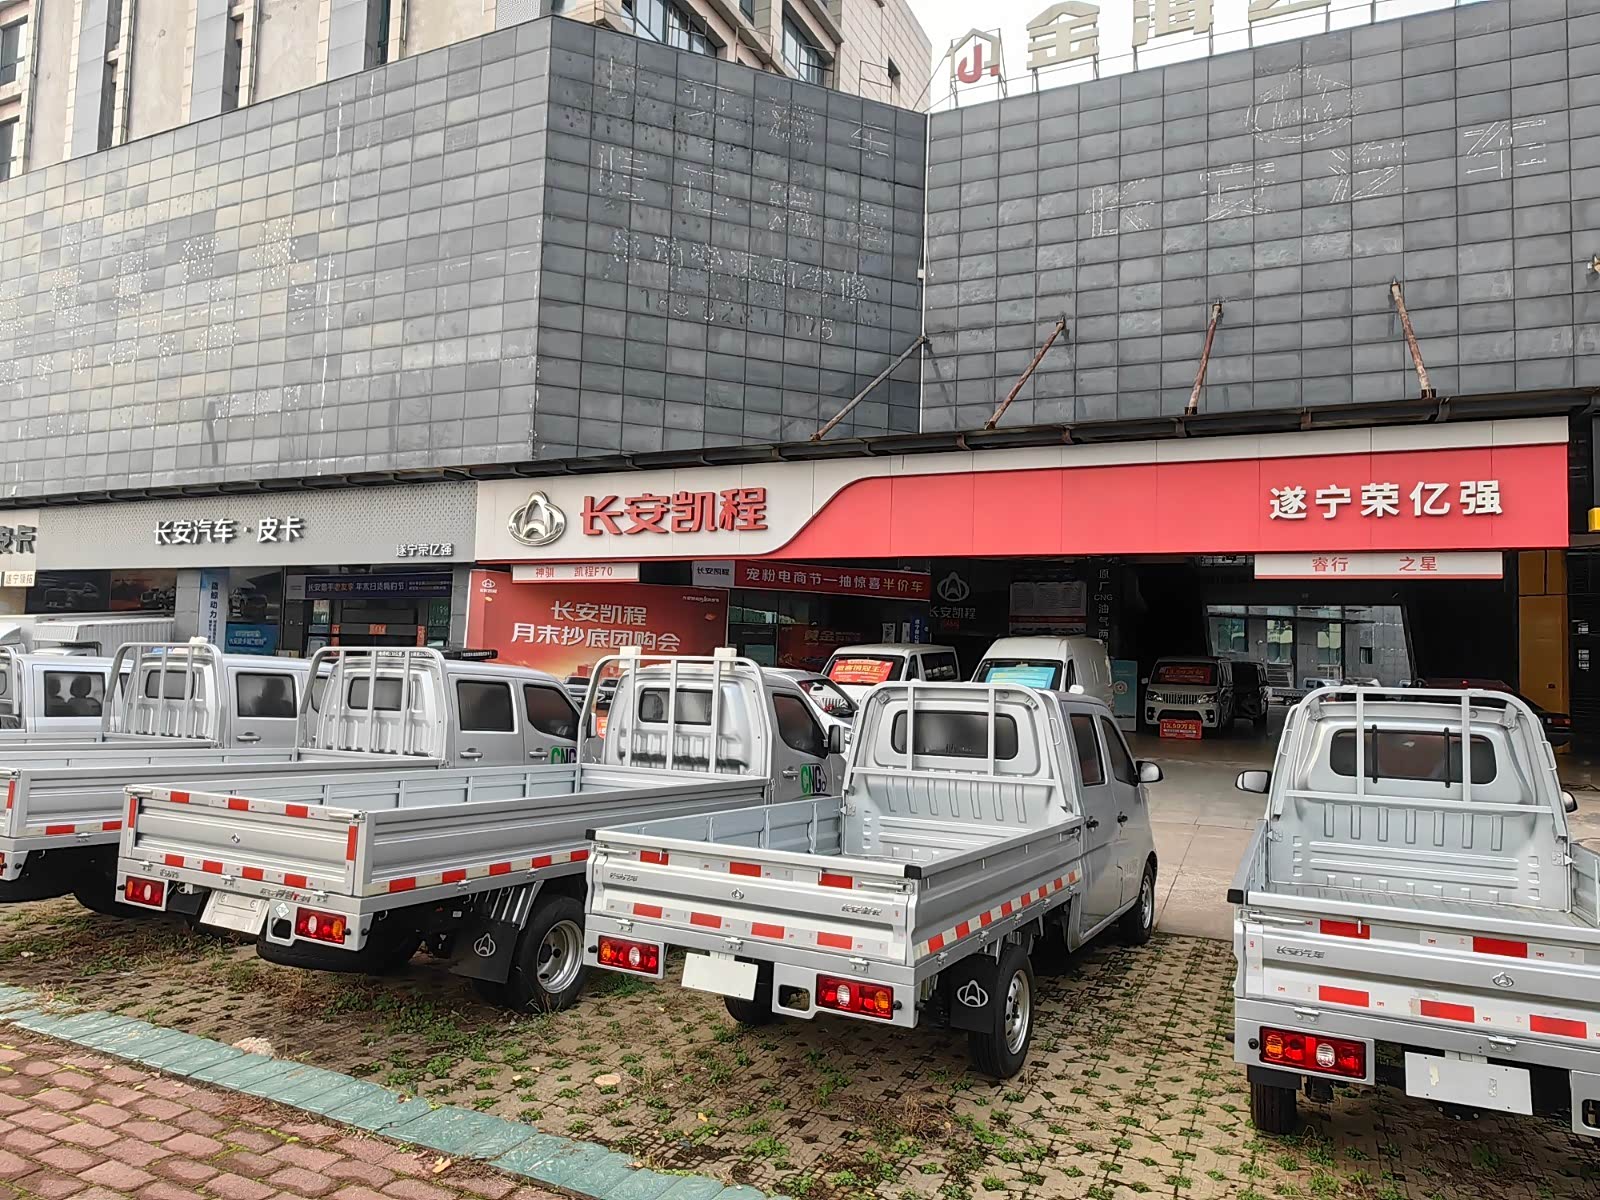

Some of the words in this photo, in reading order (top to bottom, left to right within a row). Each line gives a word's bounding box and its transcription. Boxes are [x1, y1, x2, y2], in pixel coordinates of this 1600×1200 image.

[580, 487, 768, 536] 长安凯程
[1269, 480, 1503, 520] 遂宁荣亿强
[396, 542, 453, 557] 遂宁荣亿强
[574, 566, 614, 578] 凯程F70
[1399, 556, 1438, 573] 之星
[551, 600, 647, 626] 长安凯程
[929, 606, 977, 620] 长安凯程
[511, 623, 681, 653] 月末抄底团购会
[800, 764, 822, 794] CNG
